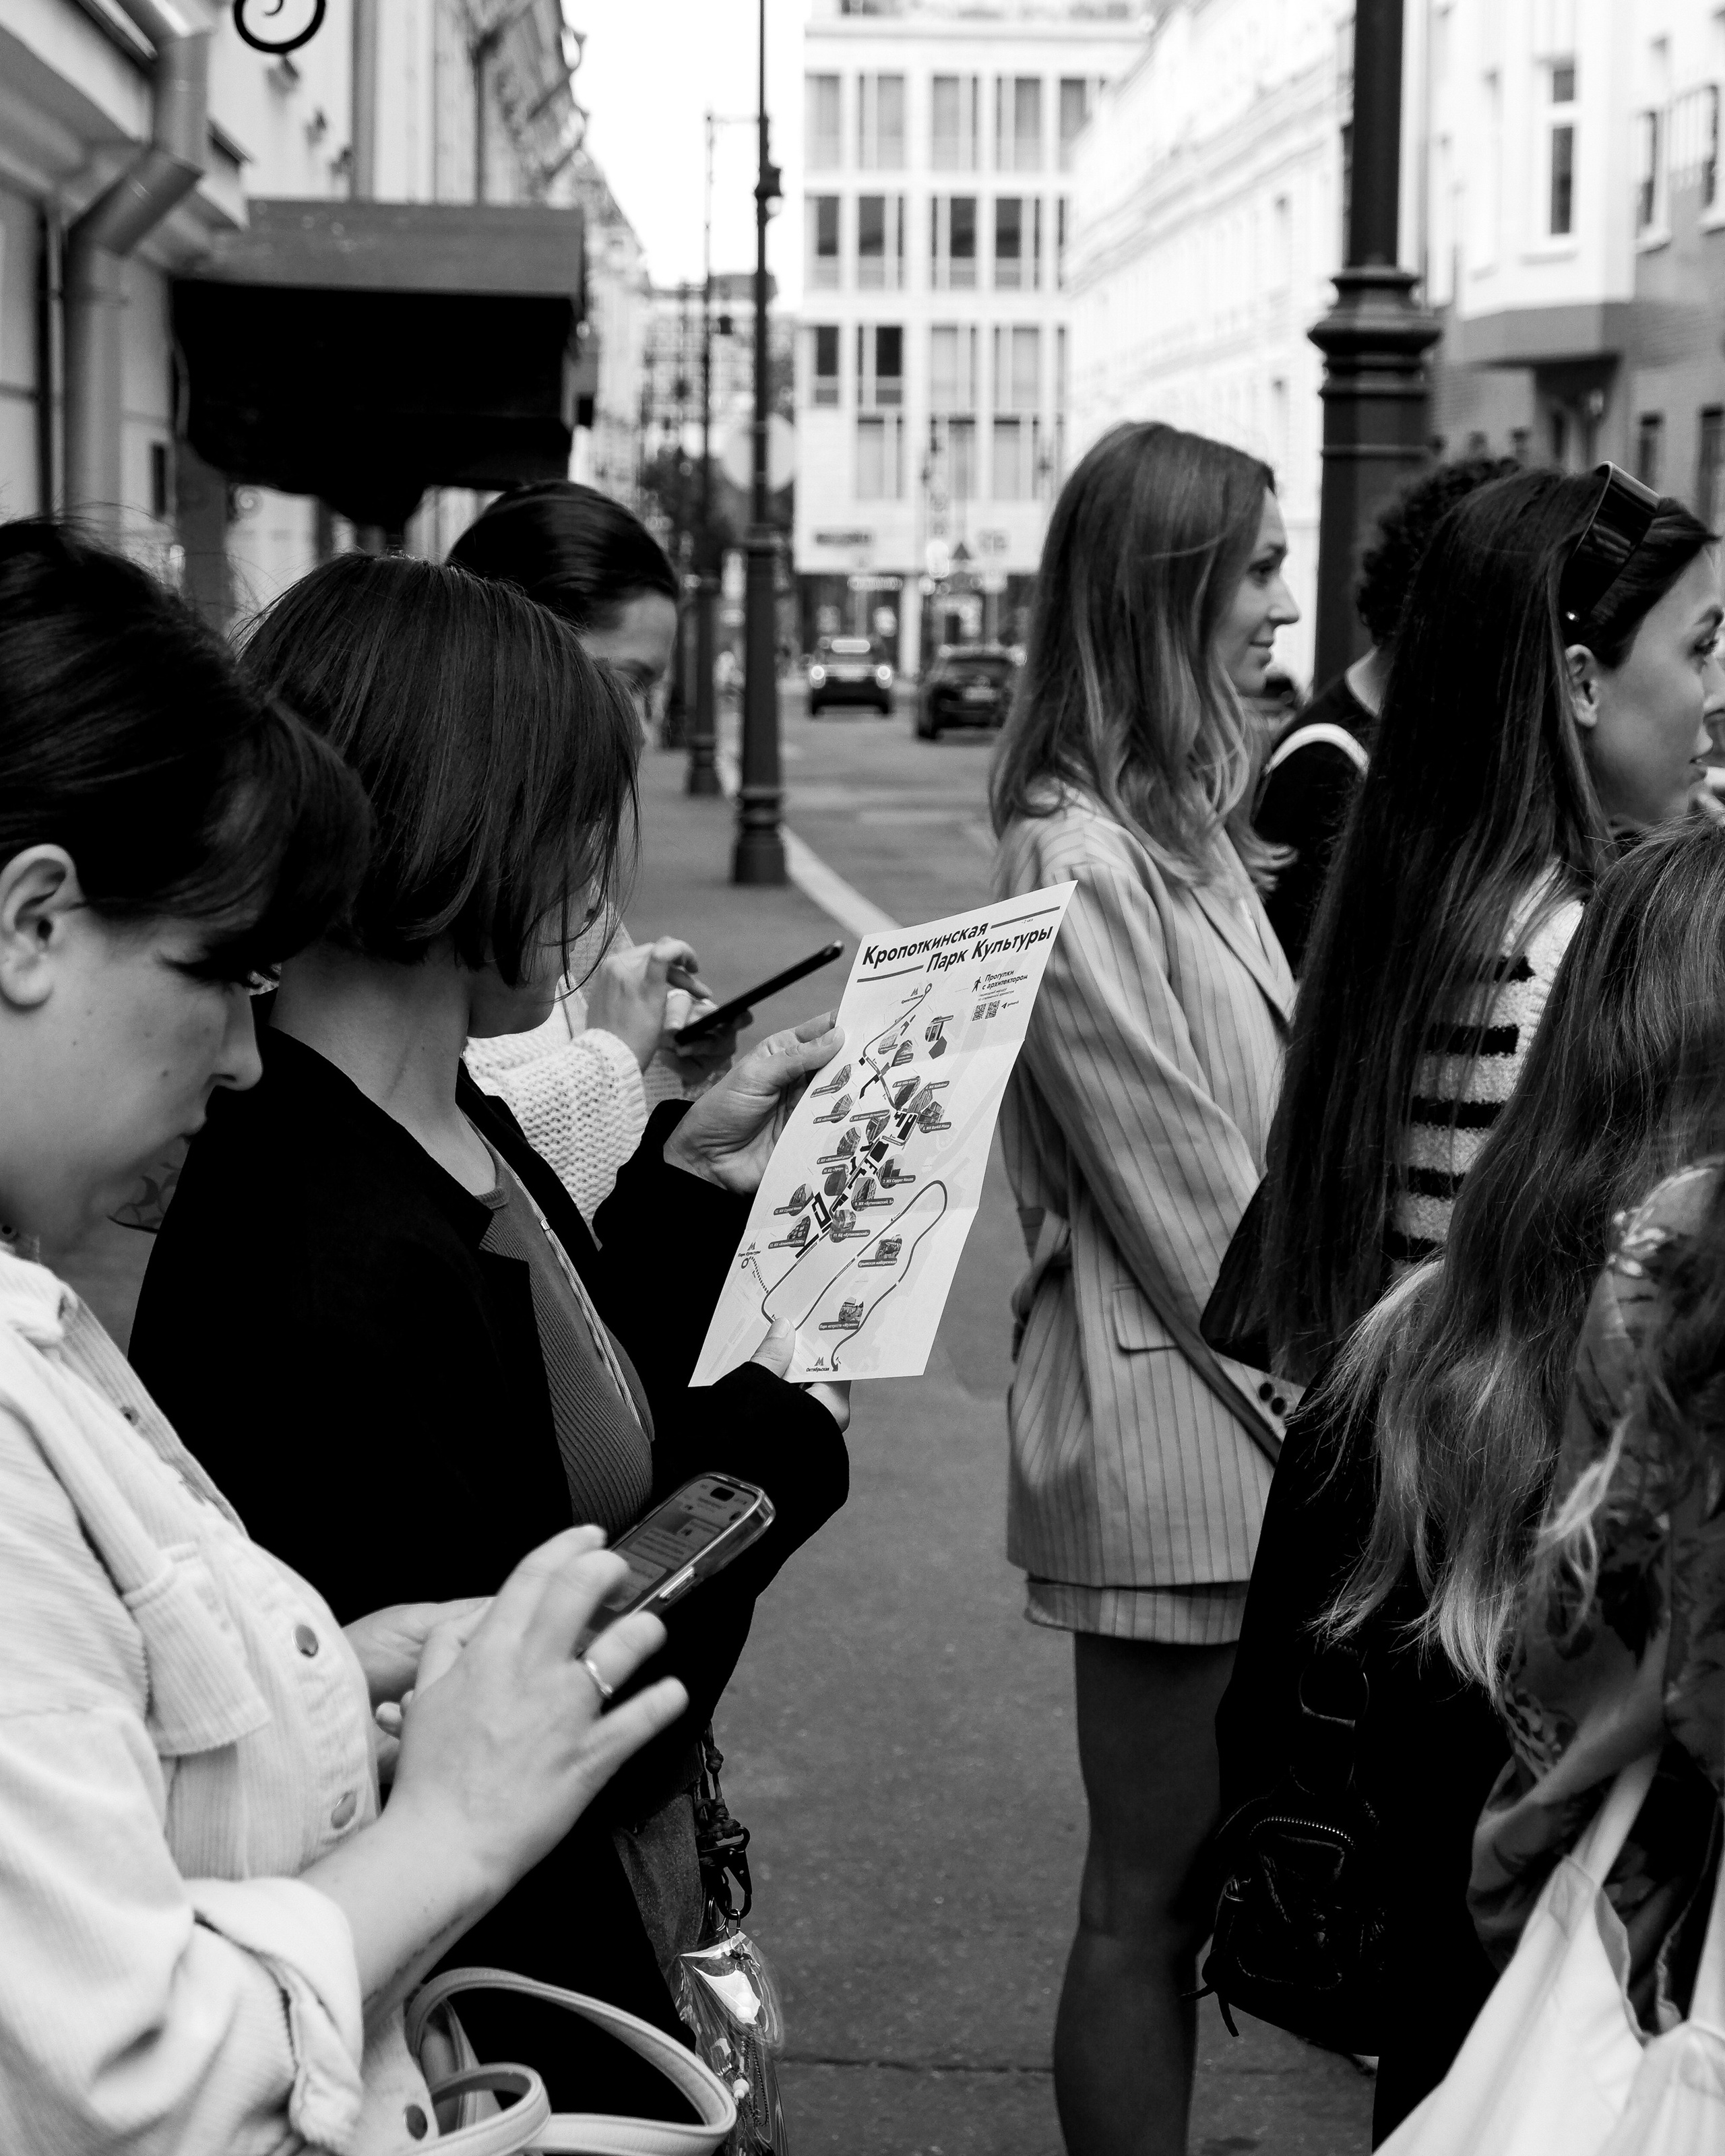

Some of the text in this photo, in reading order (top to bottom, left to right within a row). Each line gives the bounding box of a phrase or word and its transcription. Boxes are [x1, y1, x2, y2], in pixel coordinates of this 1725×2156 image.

[862, 922, 989, 970] Кропоткинская
[926, 926, 1053, 973] Парк Культуры
[984, 970, 1014, 983] Прогулки
[986, 974, 1028, 990] архитектором
